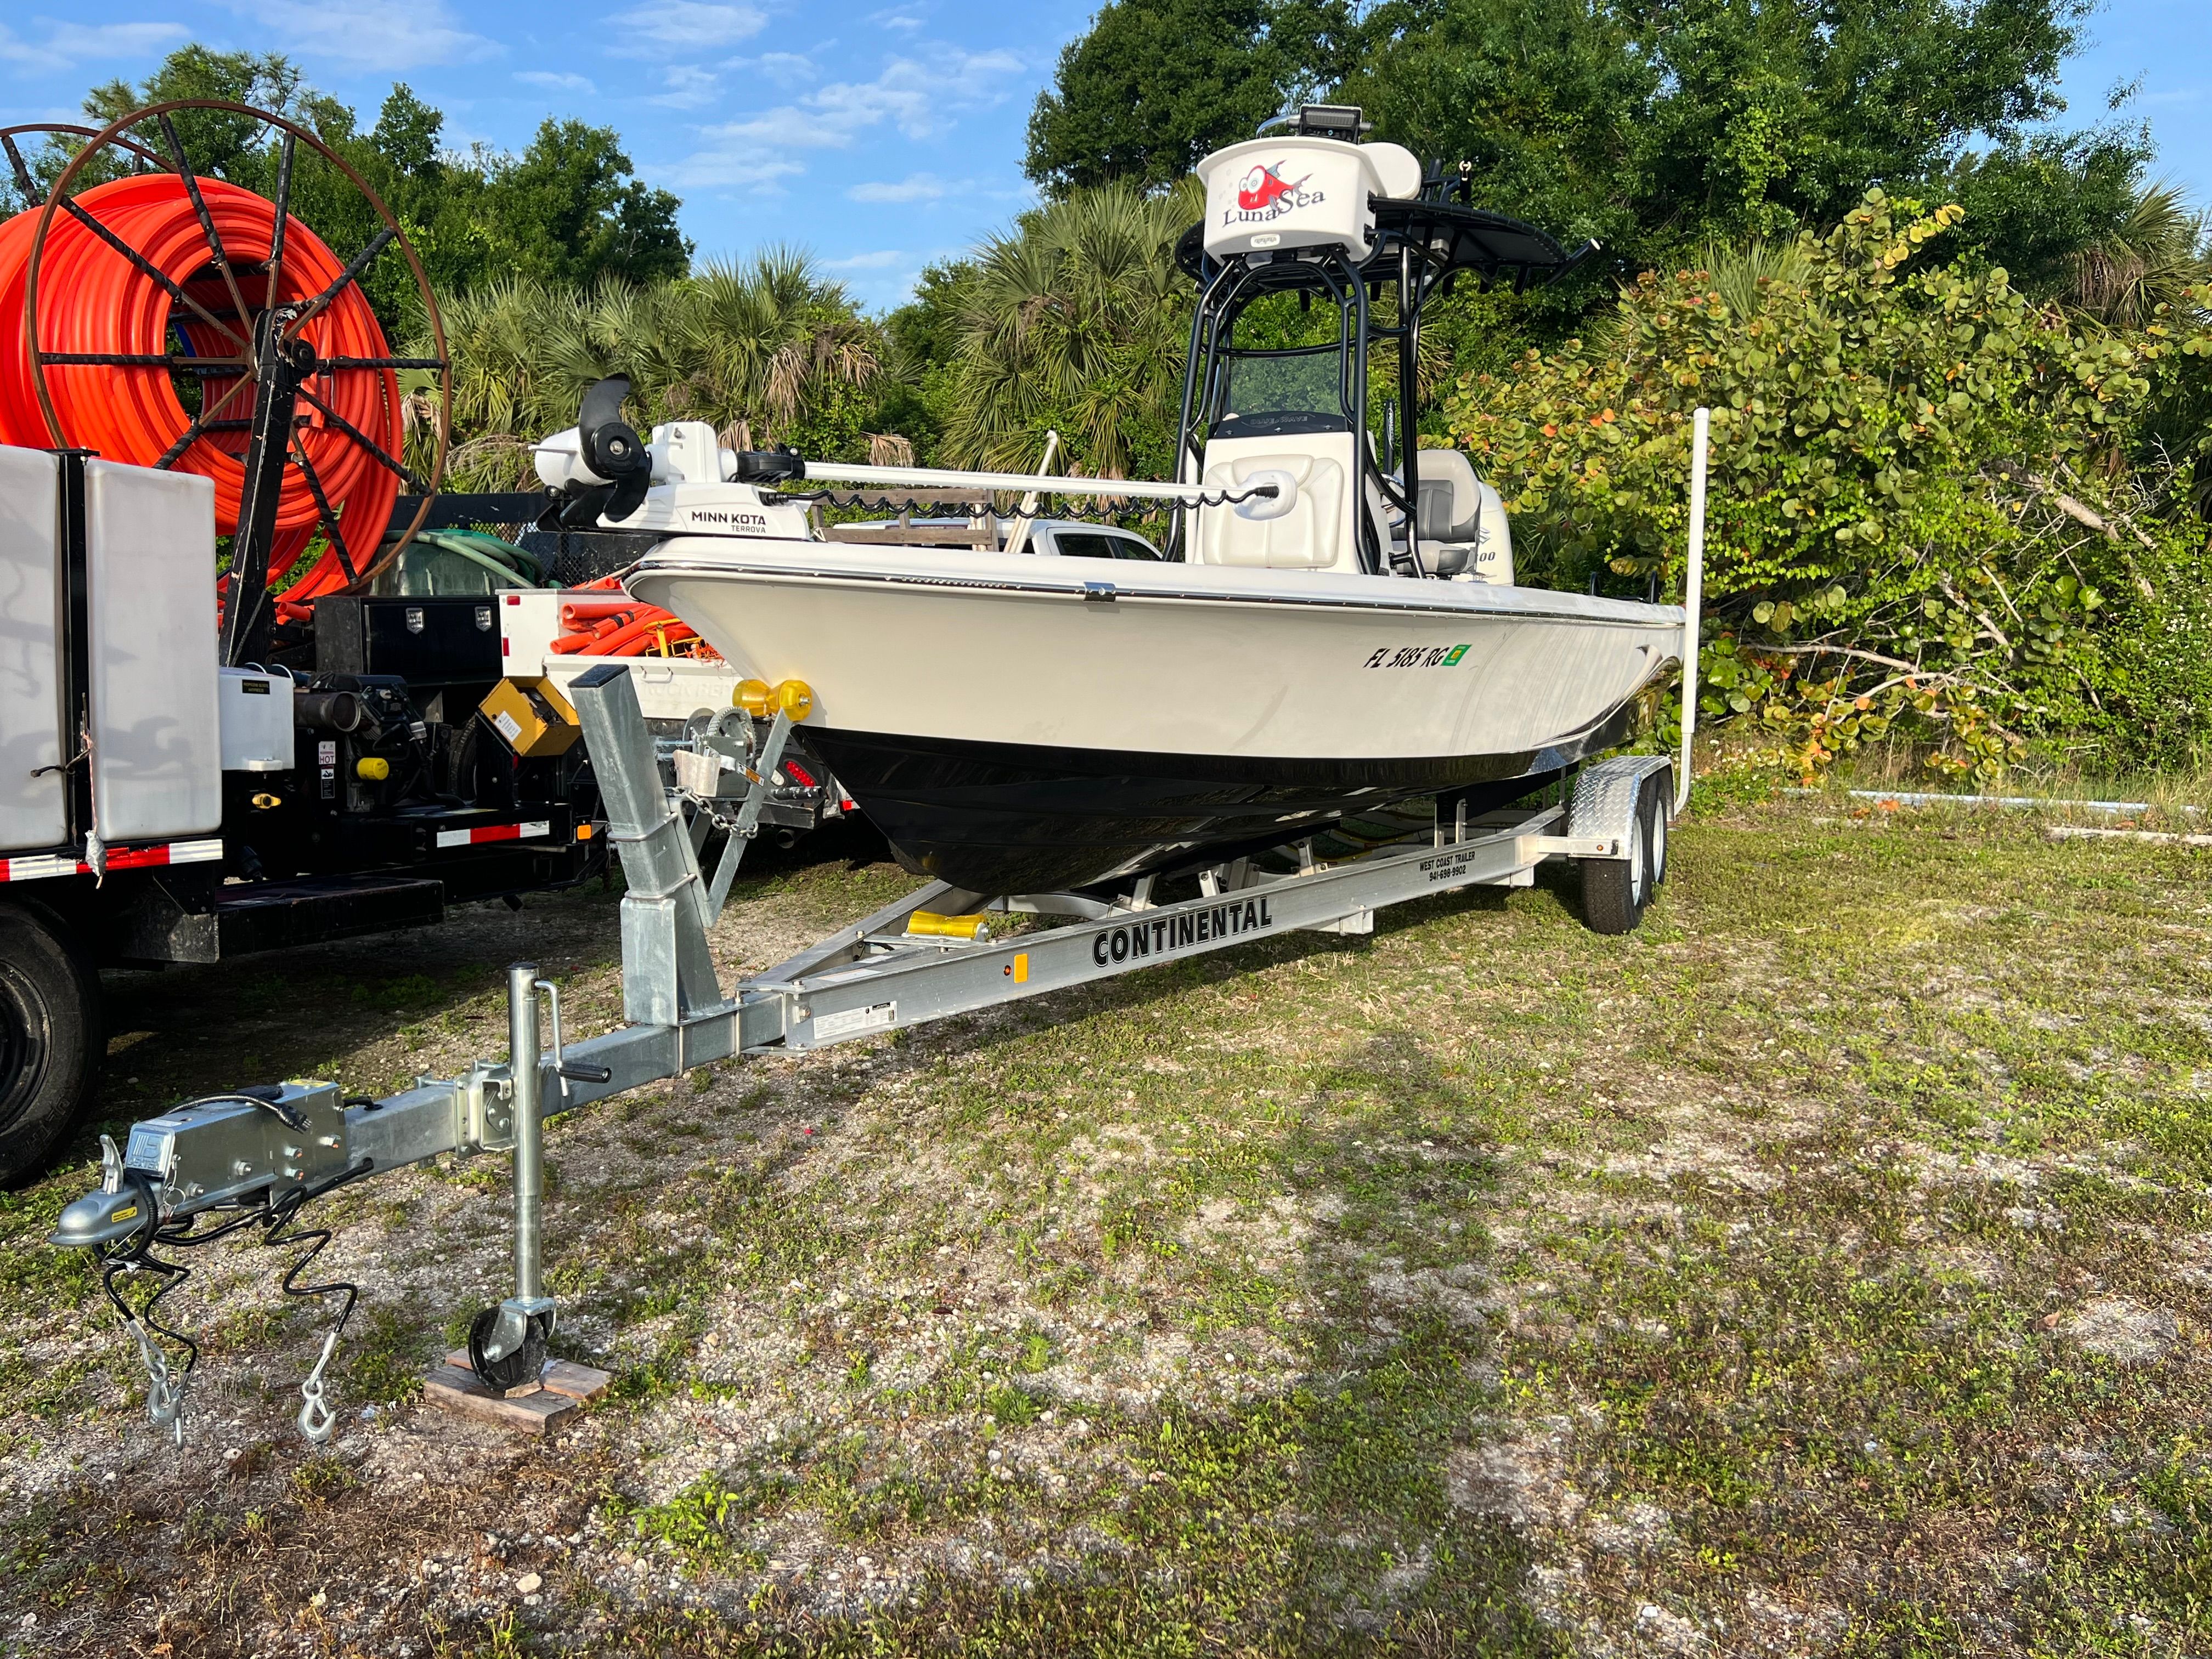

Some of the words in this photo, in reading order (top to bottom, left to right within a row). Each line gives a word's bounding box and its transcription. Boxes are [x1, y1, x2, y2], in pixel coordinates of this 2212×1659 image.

[691, 511, 727, 523] MINN
[731, 514, 766, 525] KOTA
[731, 525, 766, 533] TERROVA
[1363, 647, 1391, 668] FL
[1386, 647, 1430, 668] 5185
[1419, 647, 1450, 668] RG
[319, 755, 334, 764] HOT
[1419, 860, 1435, 872] WEST
[1436, 856, 1453, 868] COAST
[1455, 851, 1475, 864] TRAILER
[1429, 865, 1466, 882] 941-698-9902
[1092, 896, 1272, 967] CONTINENTAL
